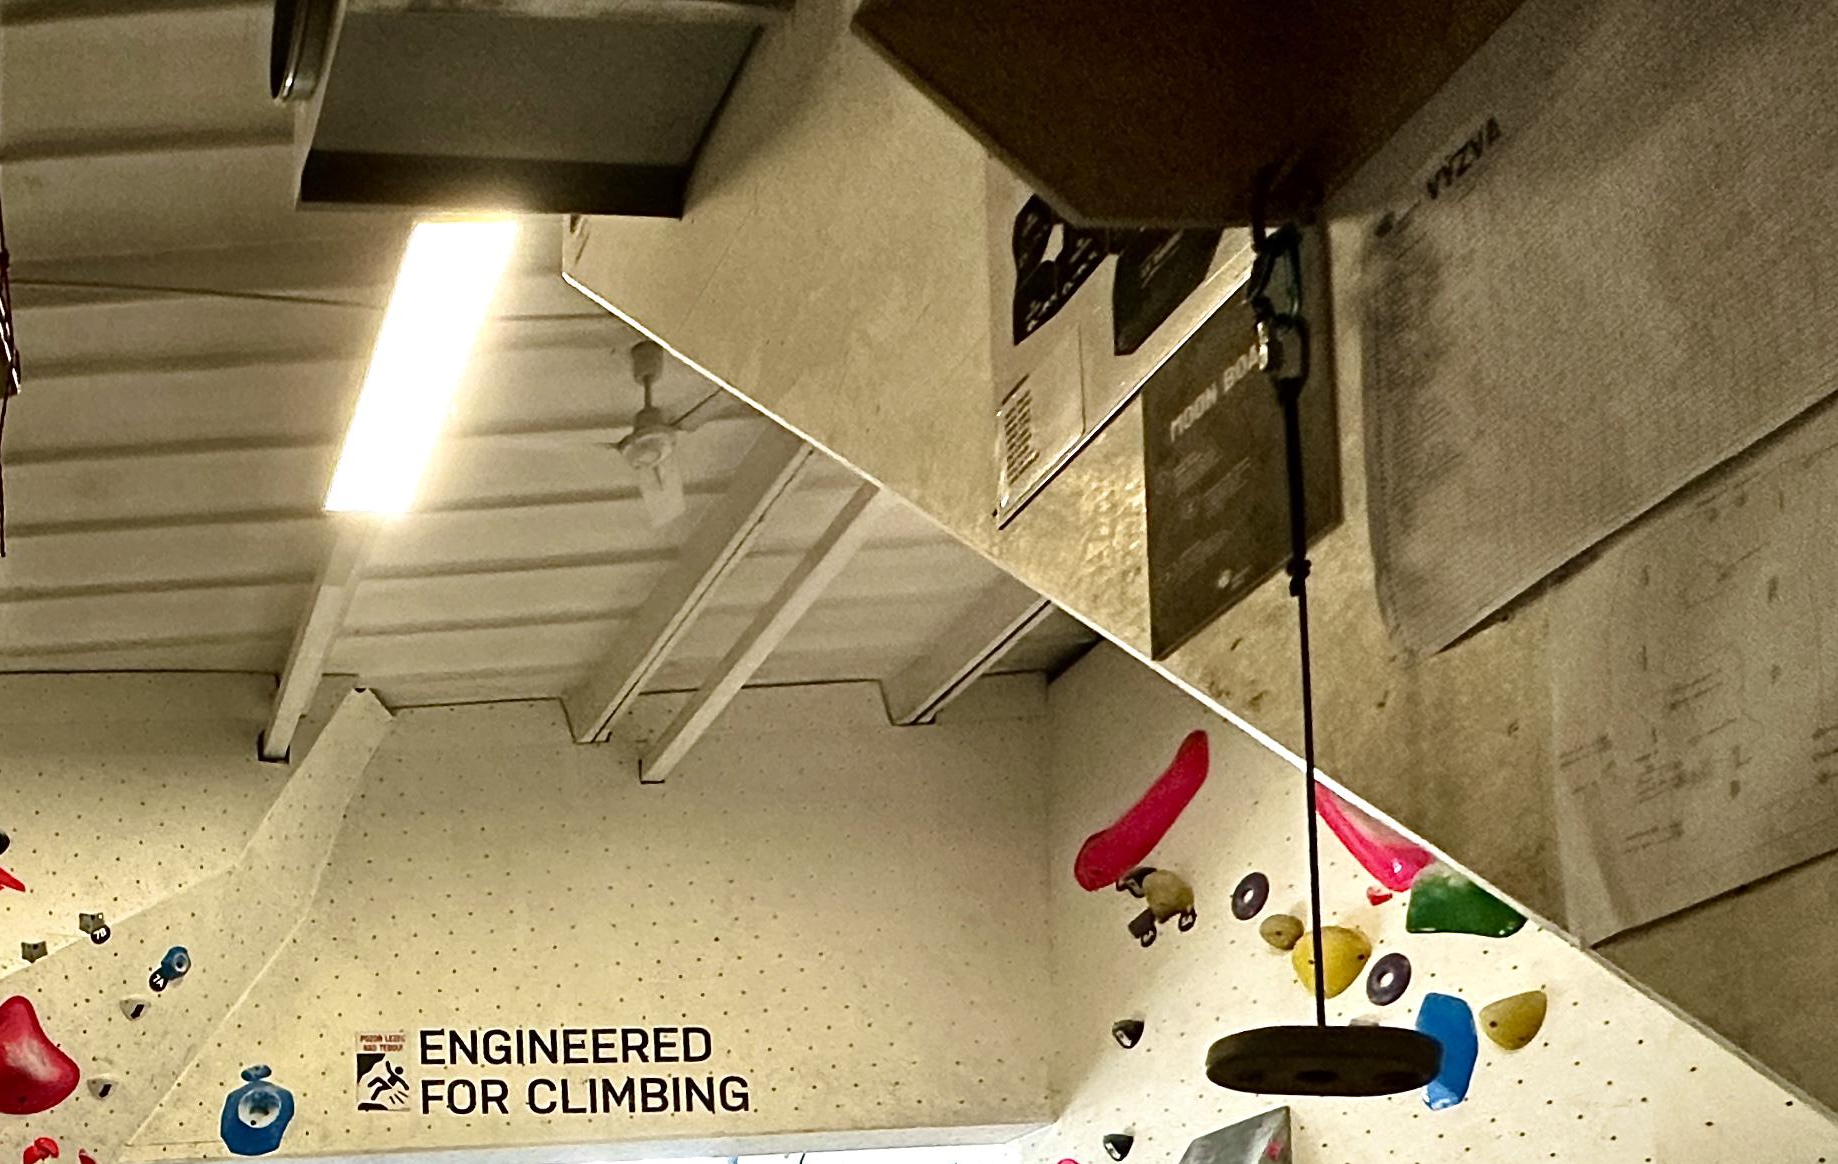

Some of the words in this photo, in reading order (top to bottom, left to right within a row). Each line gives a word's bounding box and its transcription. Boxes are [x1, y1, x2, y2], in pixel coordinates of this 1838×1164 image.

[1223, 344, 1259, 393] BOA
[418, 1026, 713, 1066] ENGINEERED
[420, 1078, 510, 1116] FOR
[526, 1075, 750, 1115] CLIMBING
